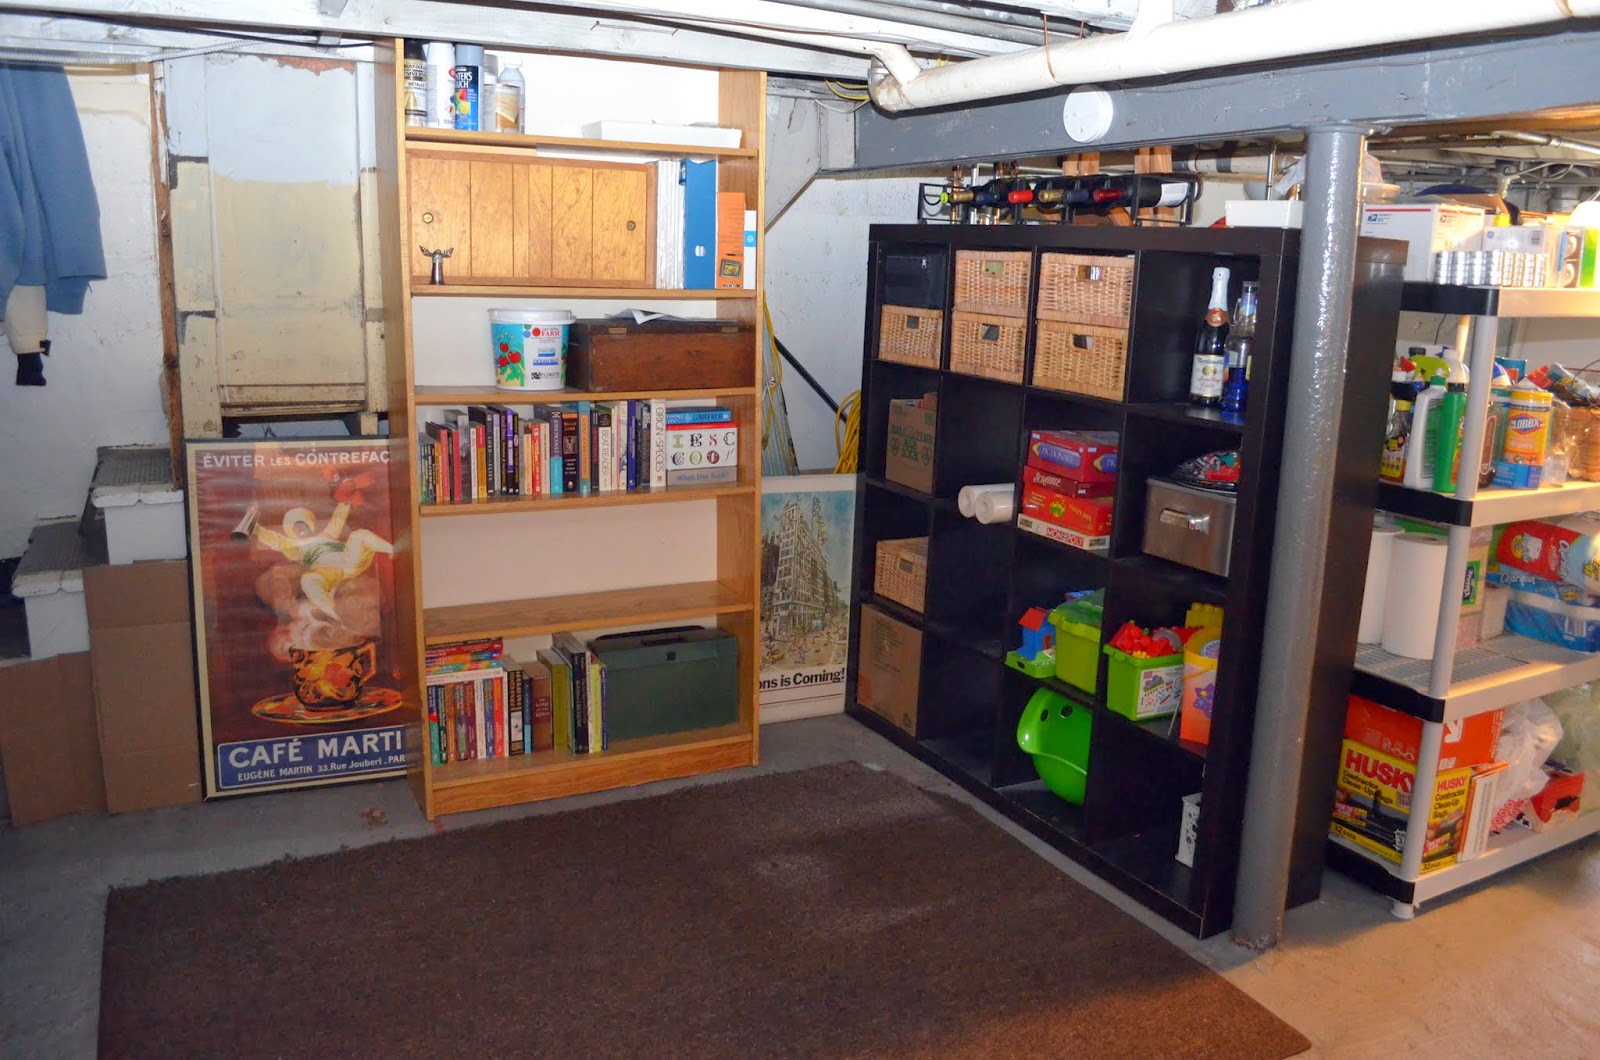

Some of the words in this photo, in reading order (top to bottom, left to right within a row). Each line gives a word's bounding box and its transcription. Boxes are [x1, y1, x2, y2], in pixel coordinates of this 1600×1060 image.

[1509, 418, 1540, 430] CLOROX
[270, 456, 291, 466] LES
[601, 448, 609, 476] READER
[1500, 571, 1536, 585] Charmin
[780, 674, 791, 687] is
[792, 667, 845, 684] Coming!
[228, 738, 303, 769] CAFÉ
[317, 730, 402, 760] MARTI
[238, 769, 276, 782] EUGÈNE
[279, 765, 313, 777] MARTIN
[349, 757, 383, 769] Joubert
[388, 754, 406, 764] PAR
[1342, 776, 1374, 796] Clean-Up
[1343, 770, 1379, 789] Contractor
[1436, 775, 1467, 792] HUSKY
[1435, 789, 1466, 801] Contractor
[1434, 799, 1460, 810] Clean-Up
[1432, 810, 1448, 819] Bags
[1422, 863, 1431, 871] 32
